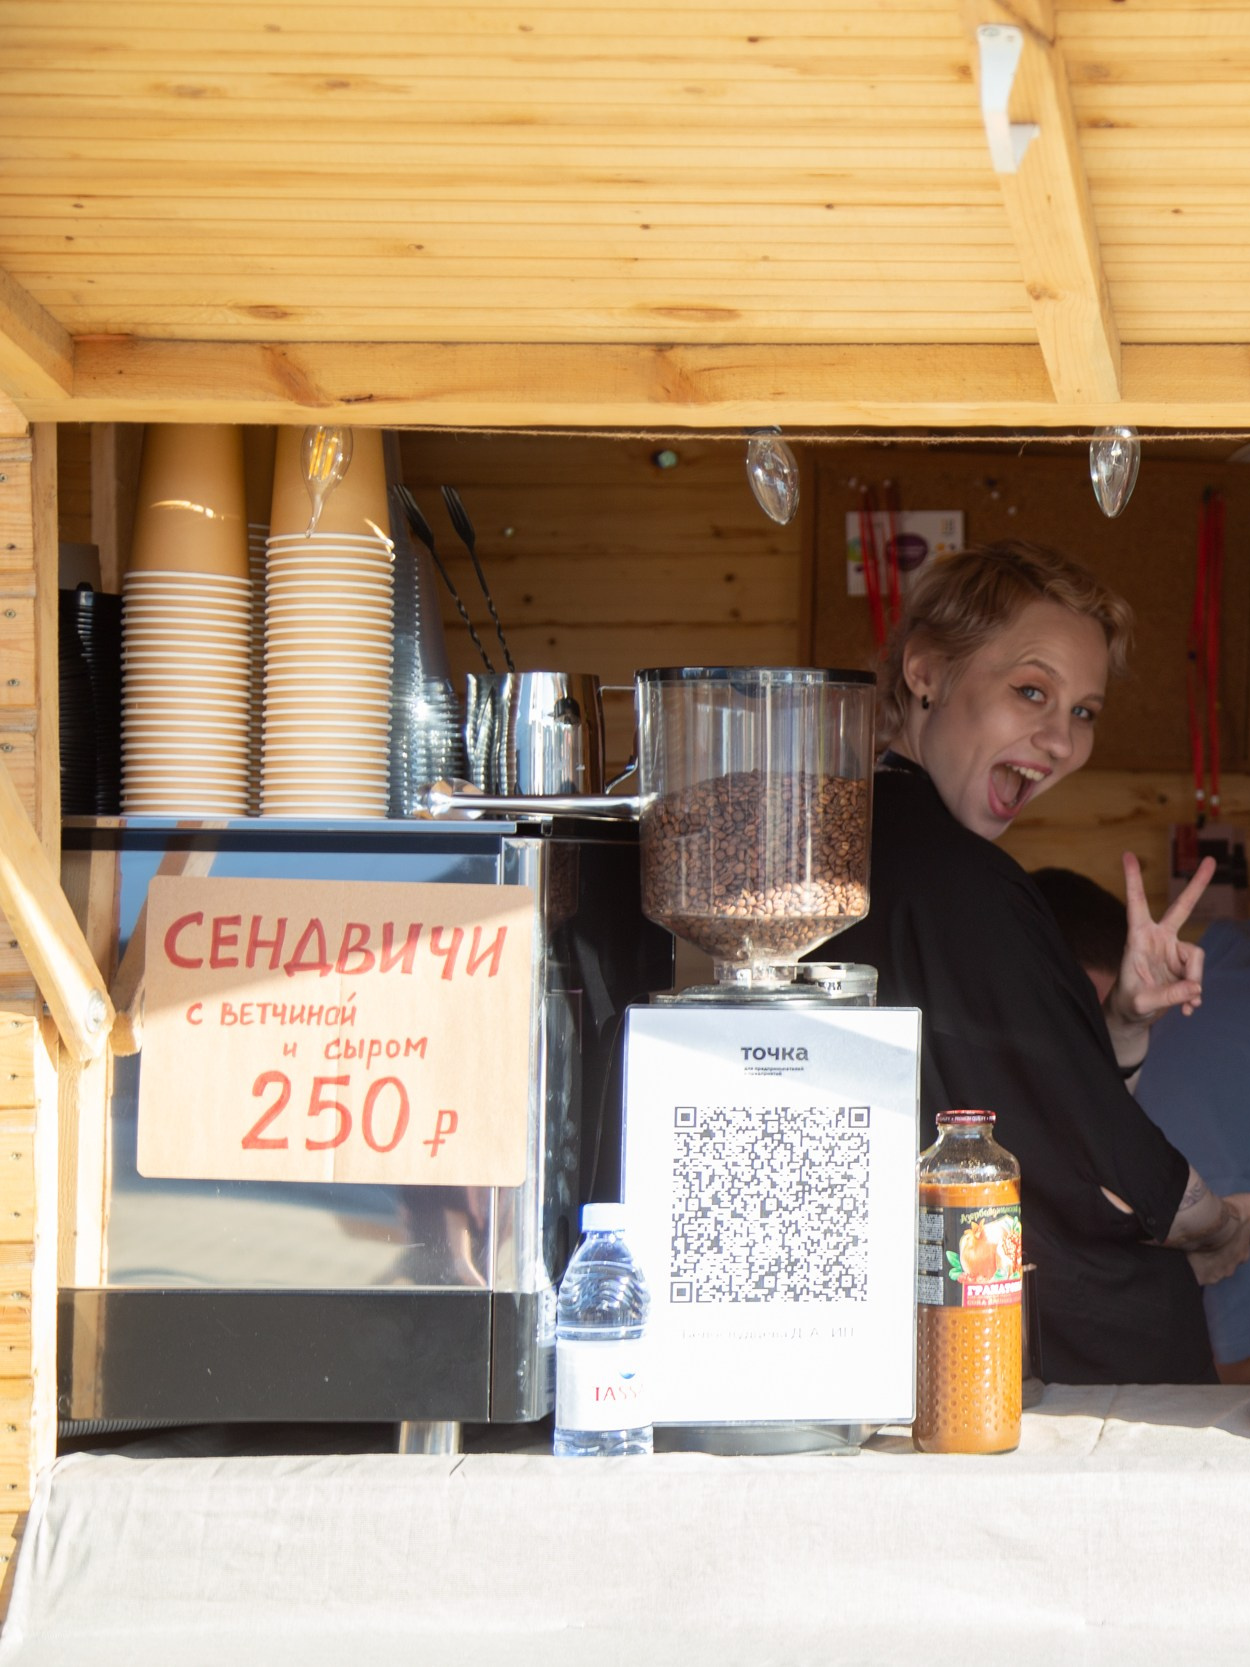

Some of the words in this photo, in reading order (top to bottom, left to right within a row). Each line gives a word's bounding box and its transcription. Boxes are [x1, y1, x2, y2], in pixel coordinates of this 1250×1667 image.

[164, 912, 507, 980] СЕНДВИЧИ
[741, 1045, 809, 1062] точка
[241, 1069, 410, 1153] 250
